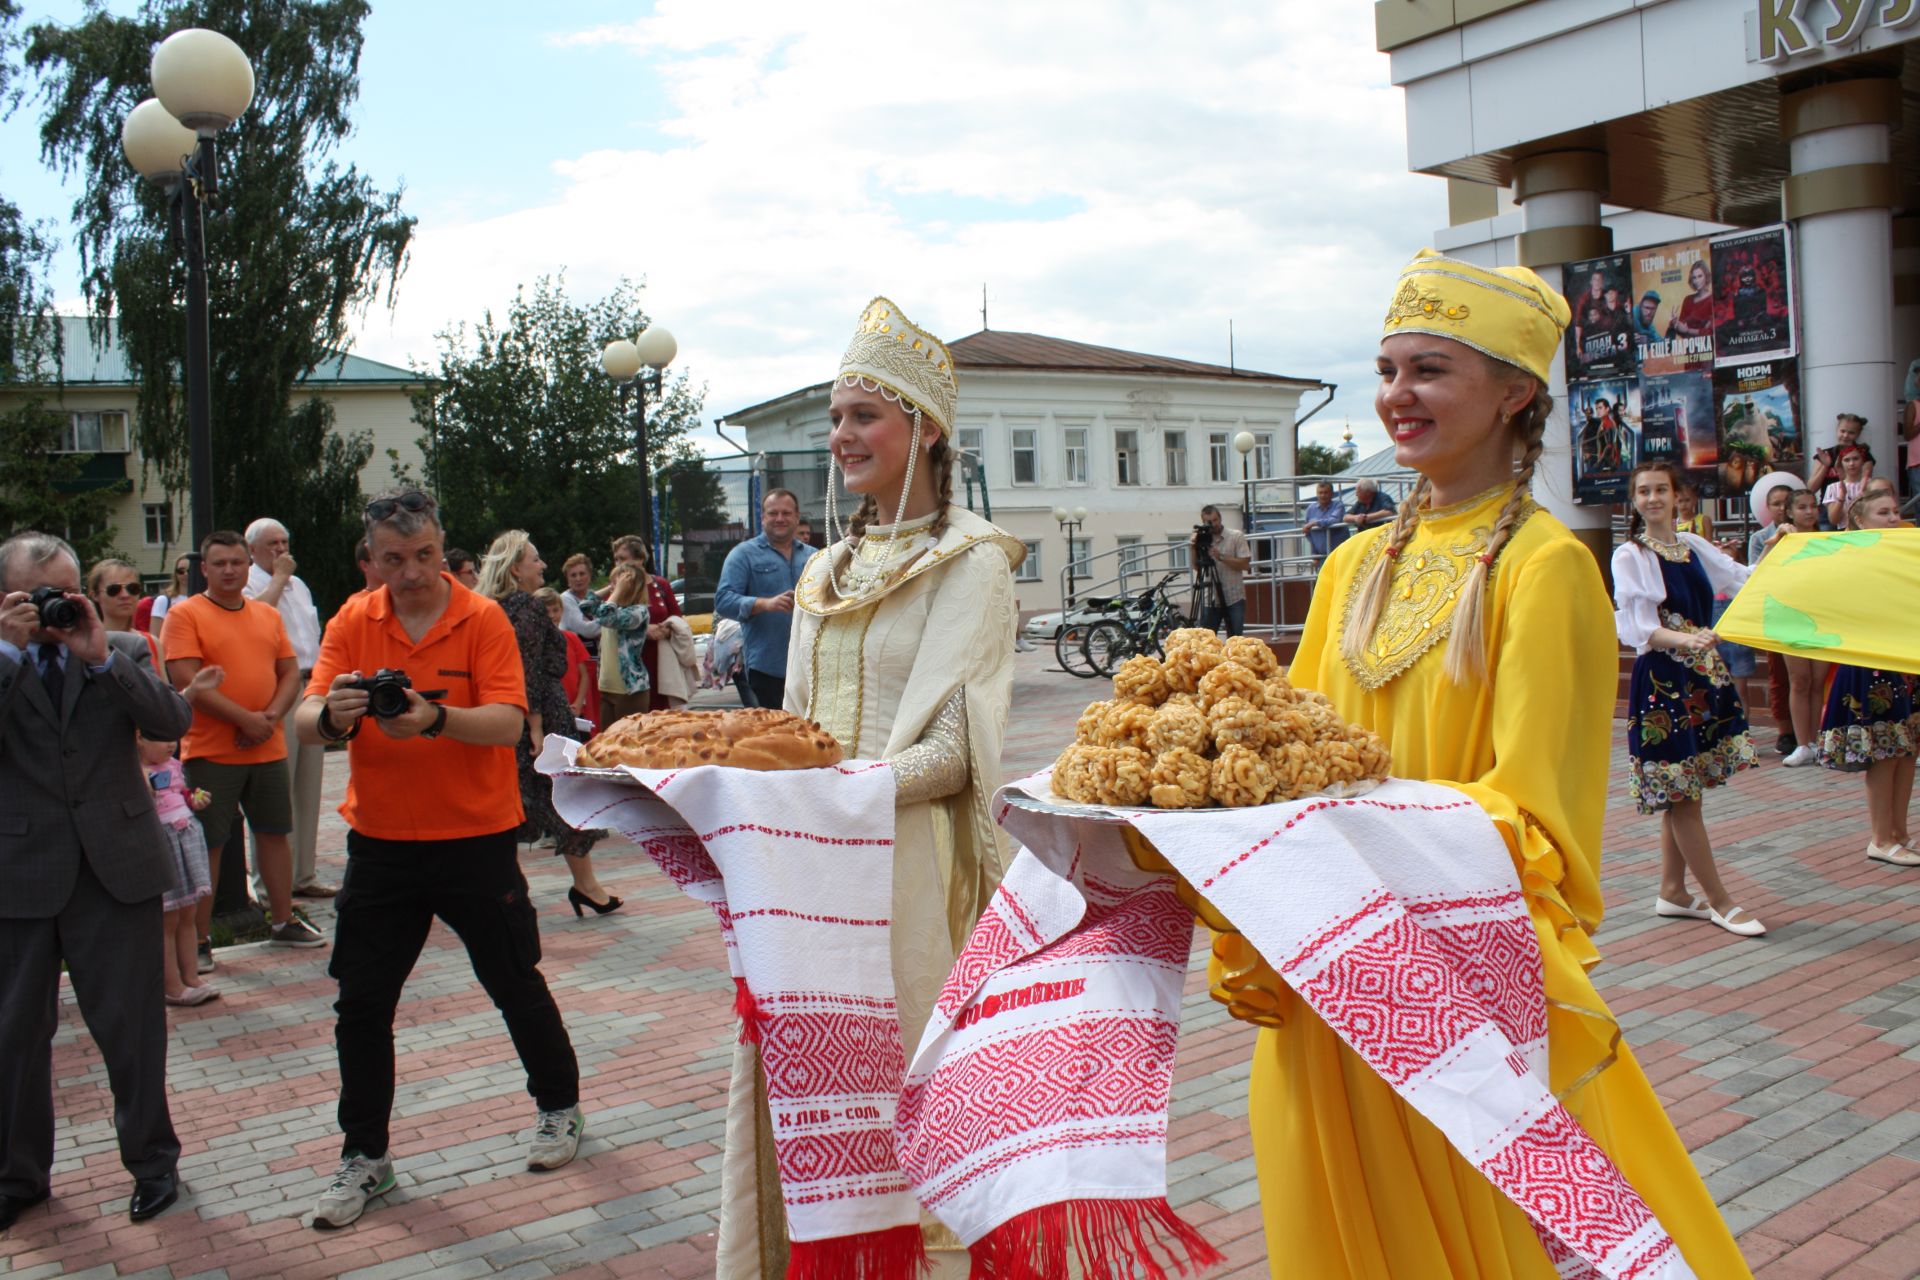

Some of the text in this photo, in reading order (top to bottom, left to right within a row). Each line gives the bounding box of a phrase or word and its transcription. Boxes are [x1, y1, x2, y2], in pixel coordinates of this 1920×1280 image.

[1640, 255, 1665, 273] ТЕРОН
[1675, 248, 1703, 266] РОГЕН
[1585, 335, 1612, 353] ПЛАН
[1617, 332, 1628, 351] 3
[1729, 332, 1769, 345] АННАБЕЛЬ
[1769, 328, 1777, 340] 3
[1637, 335, 1713, 361] ТА ЕЩЁ ПАРОЧКА
[1737, 364, 1772, 379] НОРМ
[1645, 437, 1672, 452] КУРСК
